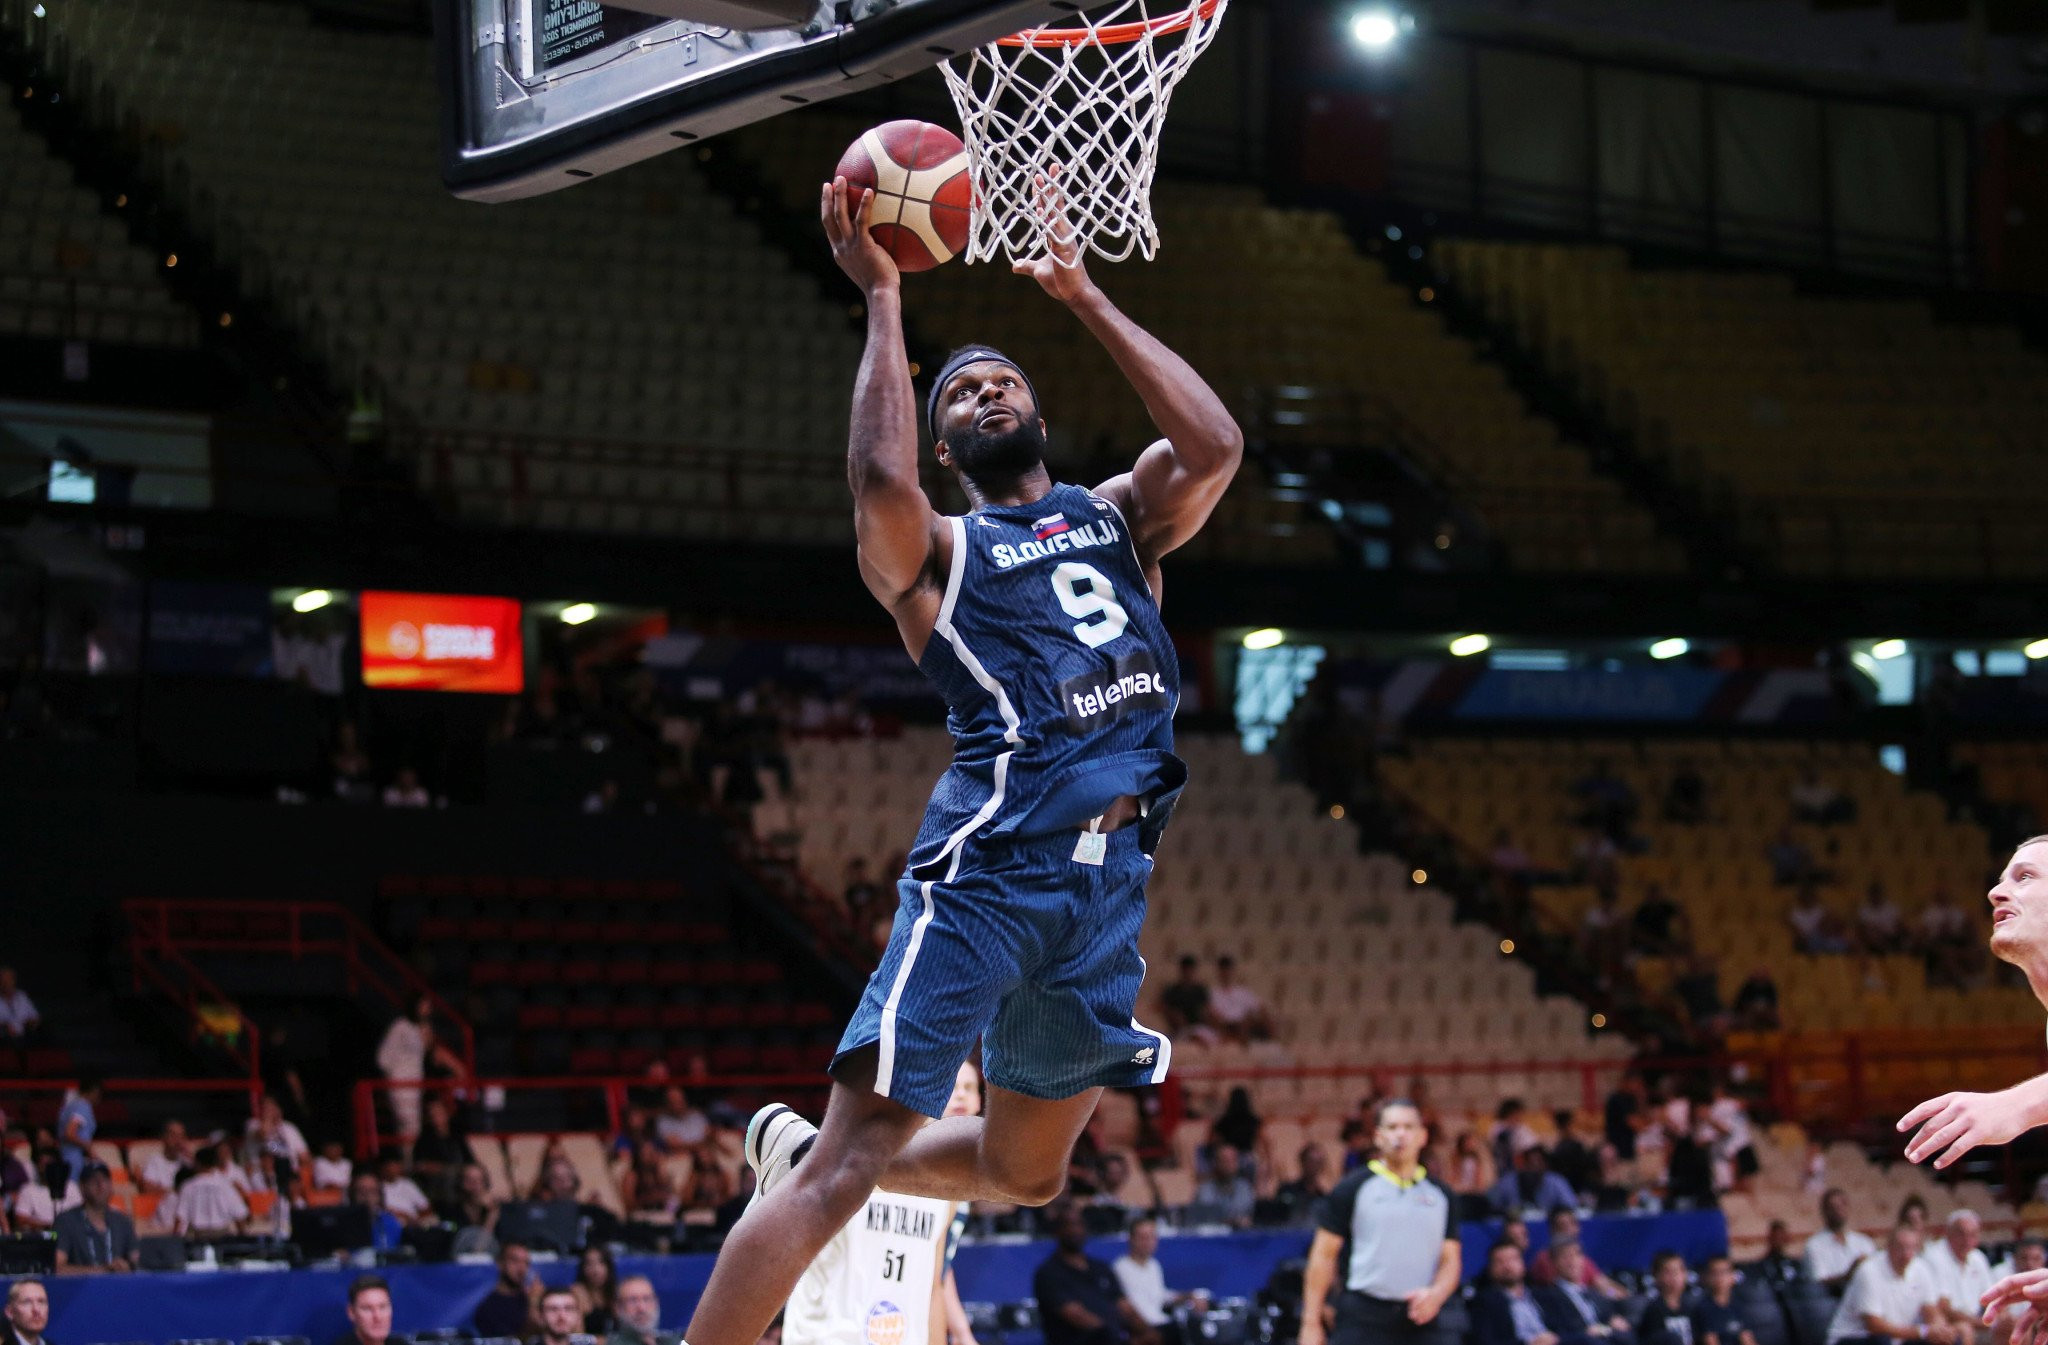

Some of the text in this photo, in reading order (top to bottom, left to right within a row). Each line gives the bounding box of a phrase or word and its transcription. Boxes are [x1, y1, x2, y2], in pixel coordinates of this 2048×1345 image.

[1051, 562, 1129, 650] 9
[867, 1202, 890, 1231] NEW
[883, 1249, 905, 1282] 51
